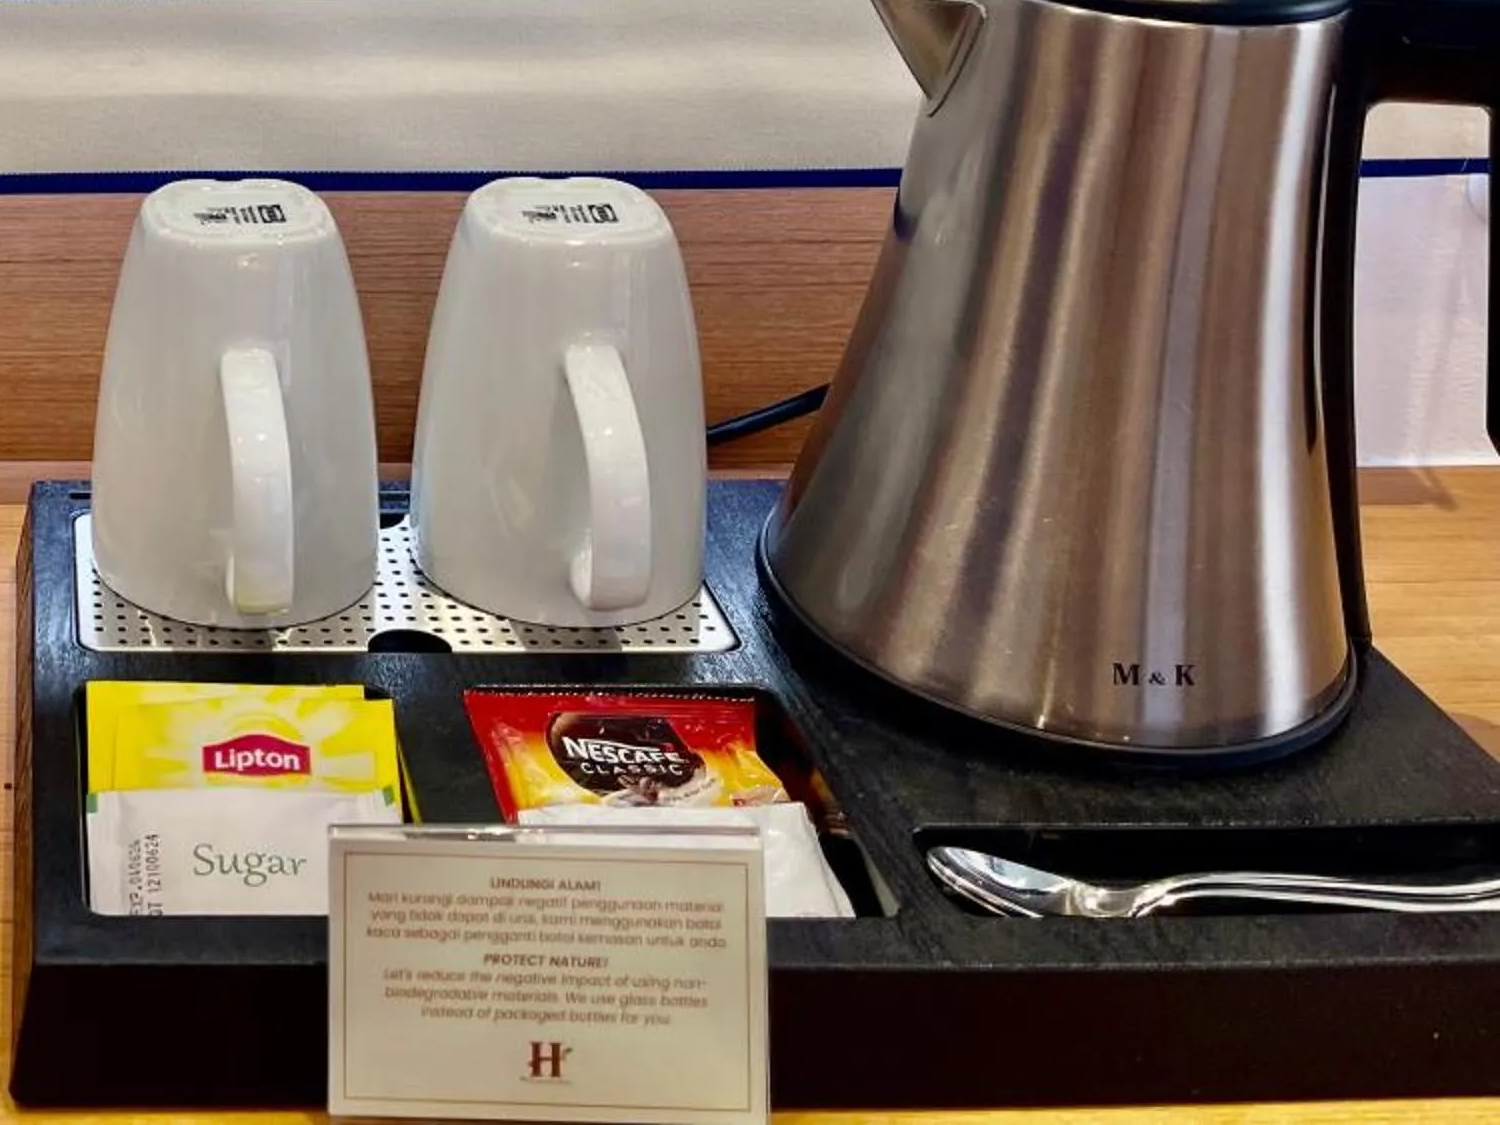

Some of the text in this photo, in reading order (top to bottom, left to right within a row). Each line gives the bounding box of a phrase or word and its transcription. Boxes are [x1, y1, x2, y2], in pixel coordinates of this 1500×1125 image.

[1112, 663, 1140, 686] M
[1175, 664, 1196, 686] K
[214, 748, 300, 771] Lipton
[580, 762, 683, 776] CLASSIC
[193, 843, 307, 887] Sugar
[484, 953, 545, 967] PROTECT
